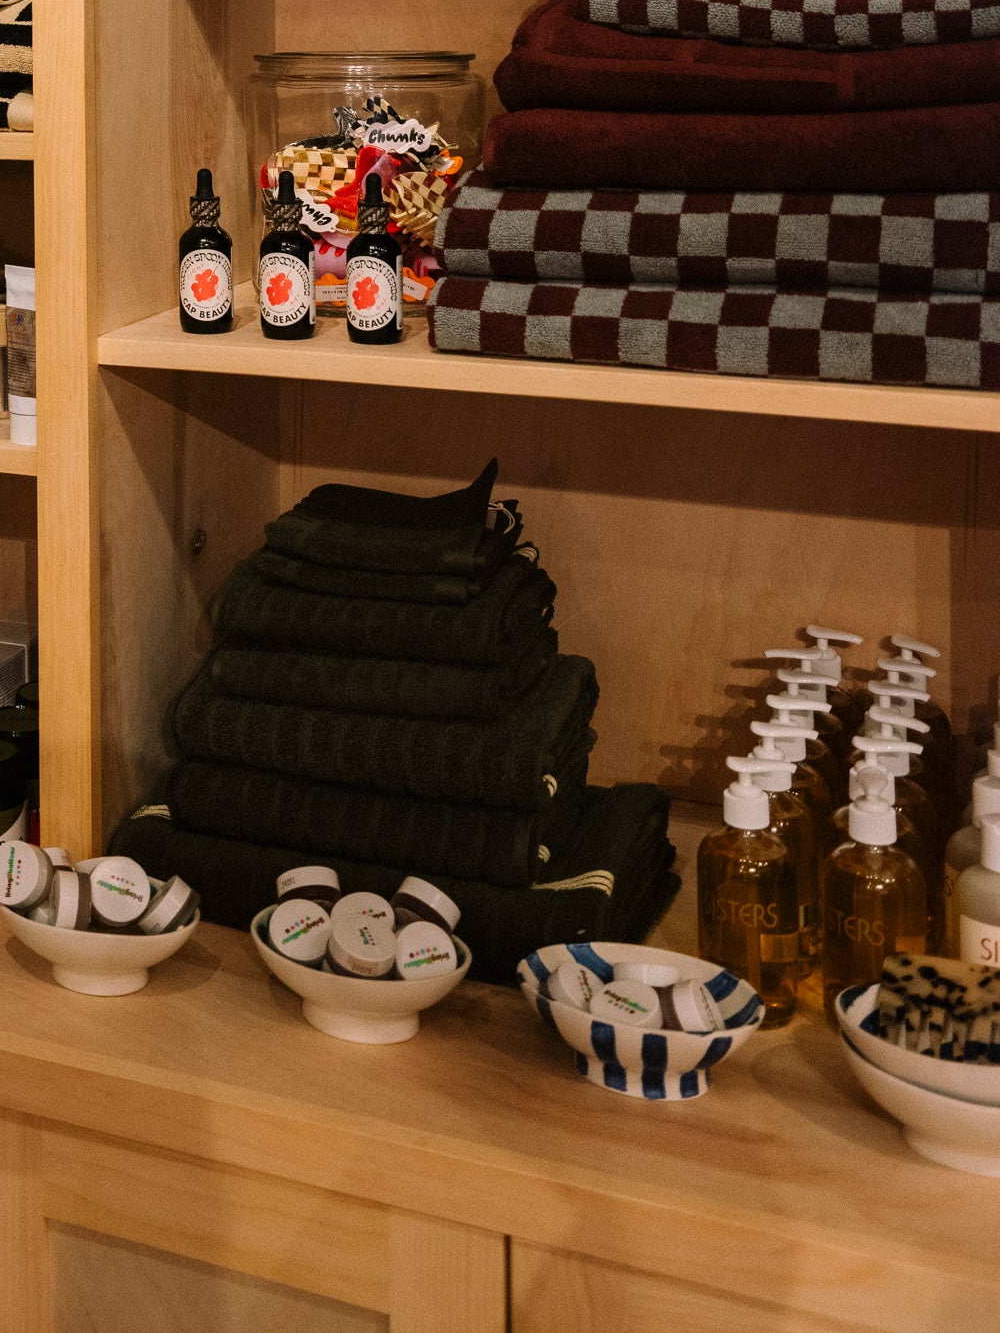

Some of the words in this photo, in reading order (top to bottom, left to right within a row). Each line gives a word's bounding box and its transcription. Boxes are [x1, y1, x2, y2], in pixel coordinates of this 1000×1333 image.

[368, 127, 425, 145] Chunks
[194, 252, 224, 265] SPOON
[268, 256, 299, 269] SPOON
[354, 259, 386, 273] SPOON
[183, 298, 197, 314] CAP
[199, 296, 230, 319] BEAUTY
[273, 301, 308, 324] BEAUTY
[358, 307, 394, 328] BEAUTY
[714, 898, 779, 928] STERS
[829, 909, 885, 946] TERS
